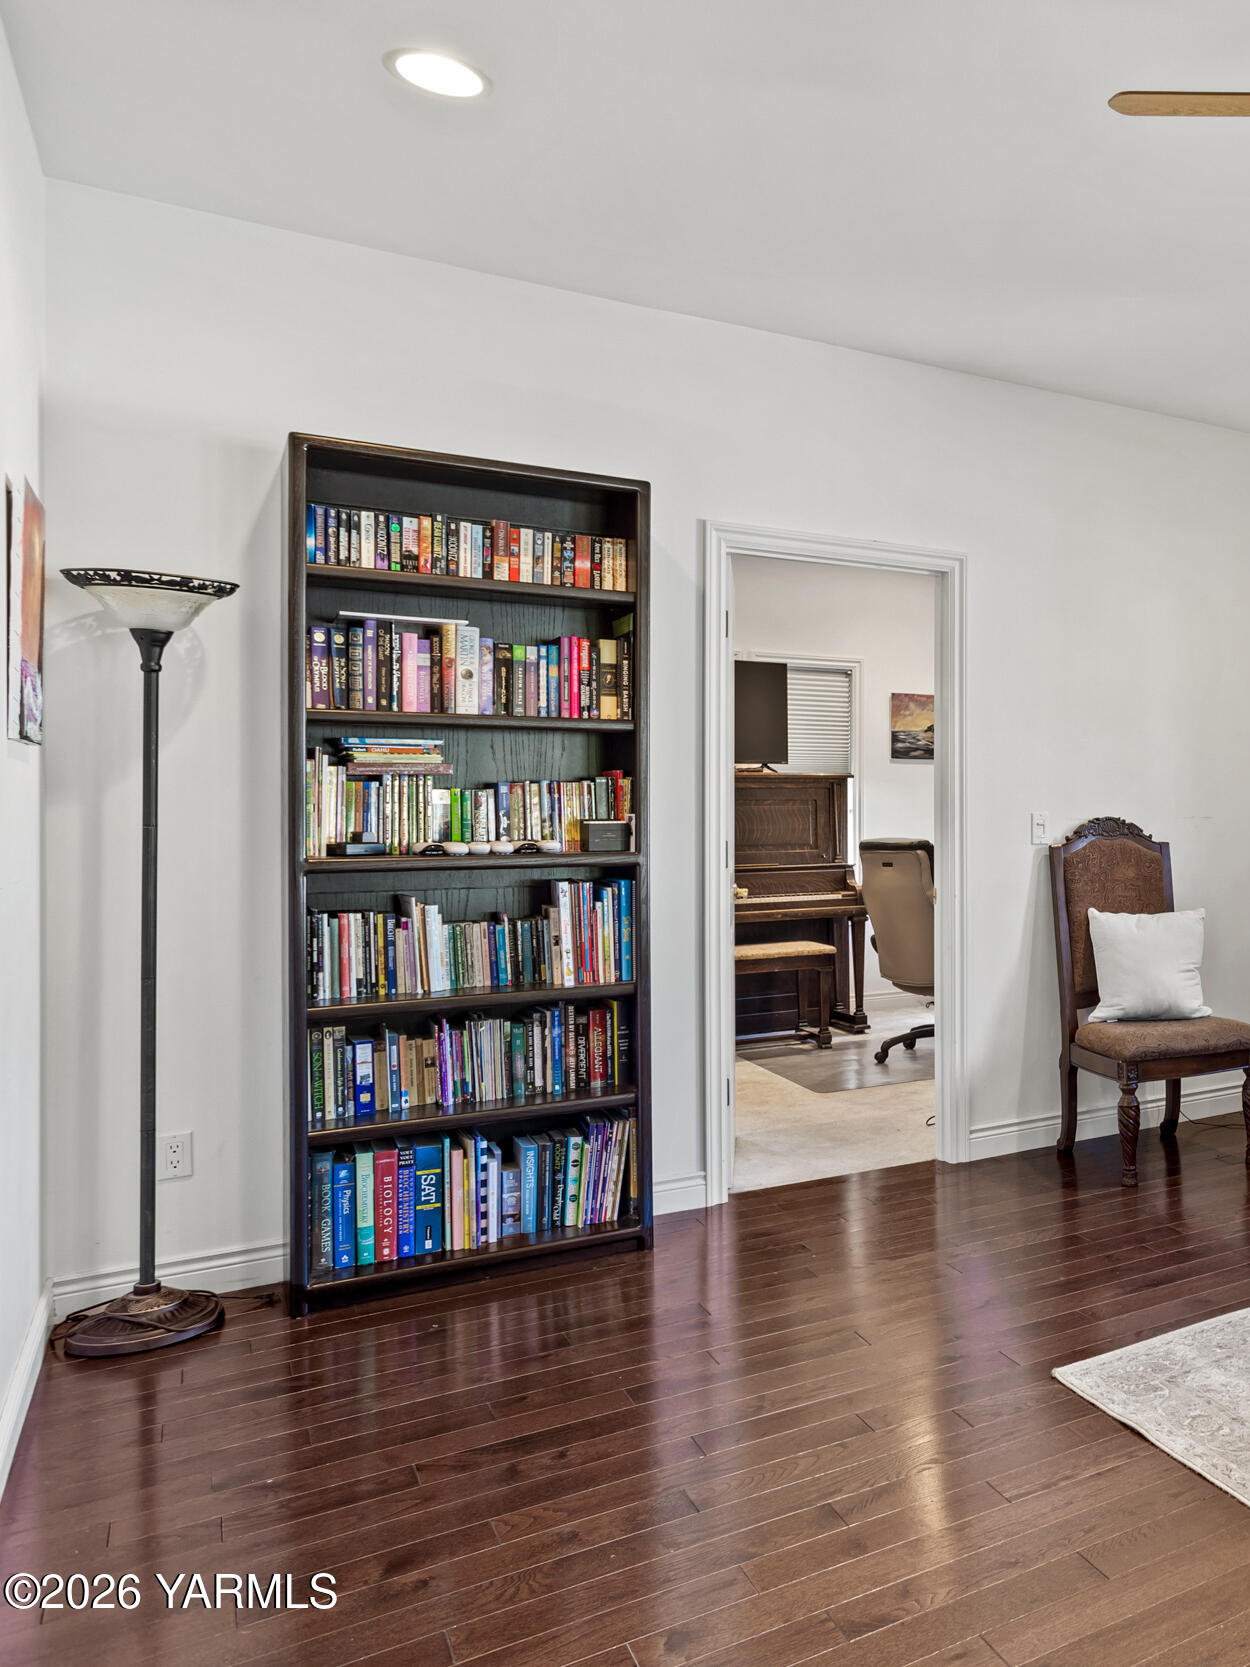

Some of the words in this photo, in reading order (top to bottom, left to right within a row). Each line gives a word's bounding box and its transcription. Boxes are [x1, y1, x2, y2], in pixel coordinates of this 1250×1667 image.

[460, 634, 469, 666] MARTIN
[312, 661, 321, 692] OLYMPUS
[320, 666, 329, 690] BLOOD
[339, 666, 348, 683] SON
[313, 1051, 322, 1070] SON
[577, 1036, 586, 1080] DIVERGENT
[594, 1027, 603, 1074] ALLEGIANT
[314, 1079, 324, 1110] WITCH
[526, 1150, 536, 1189] INSIGHTS
[321, 1184, 331, 1213] BOOK
[342, 1189, 352, 1215] Physics
[402, 1169, 410, 1234] BIOCHEMISTRY
[421, 1174, 436, 1203] SAT
[383, 1176, 393, 1233] BIOLOGY
[321, 1218, 331, 1253] GAMES
